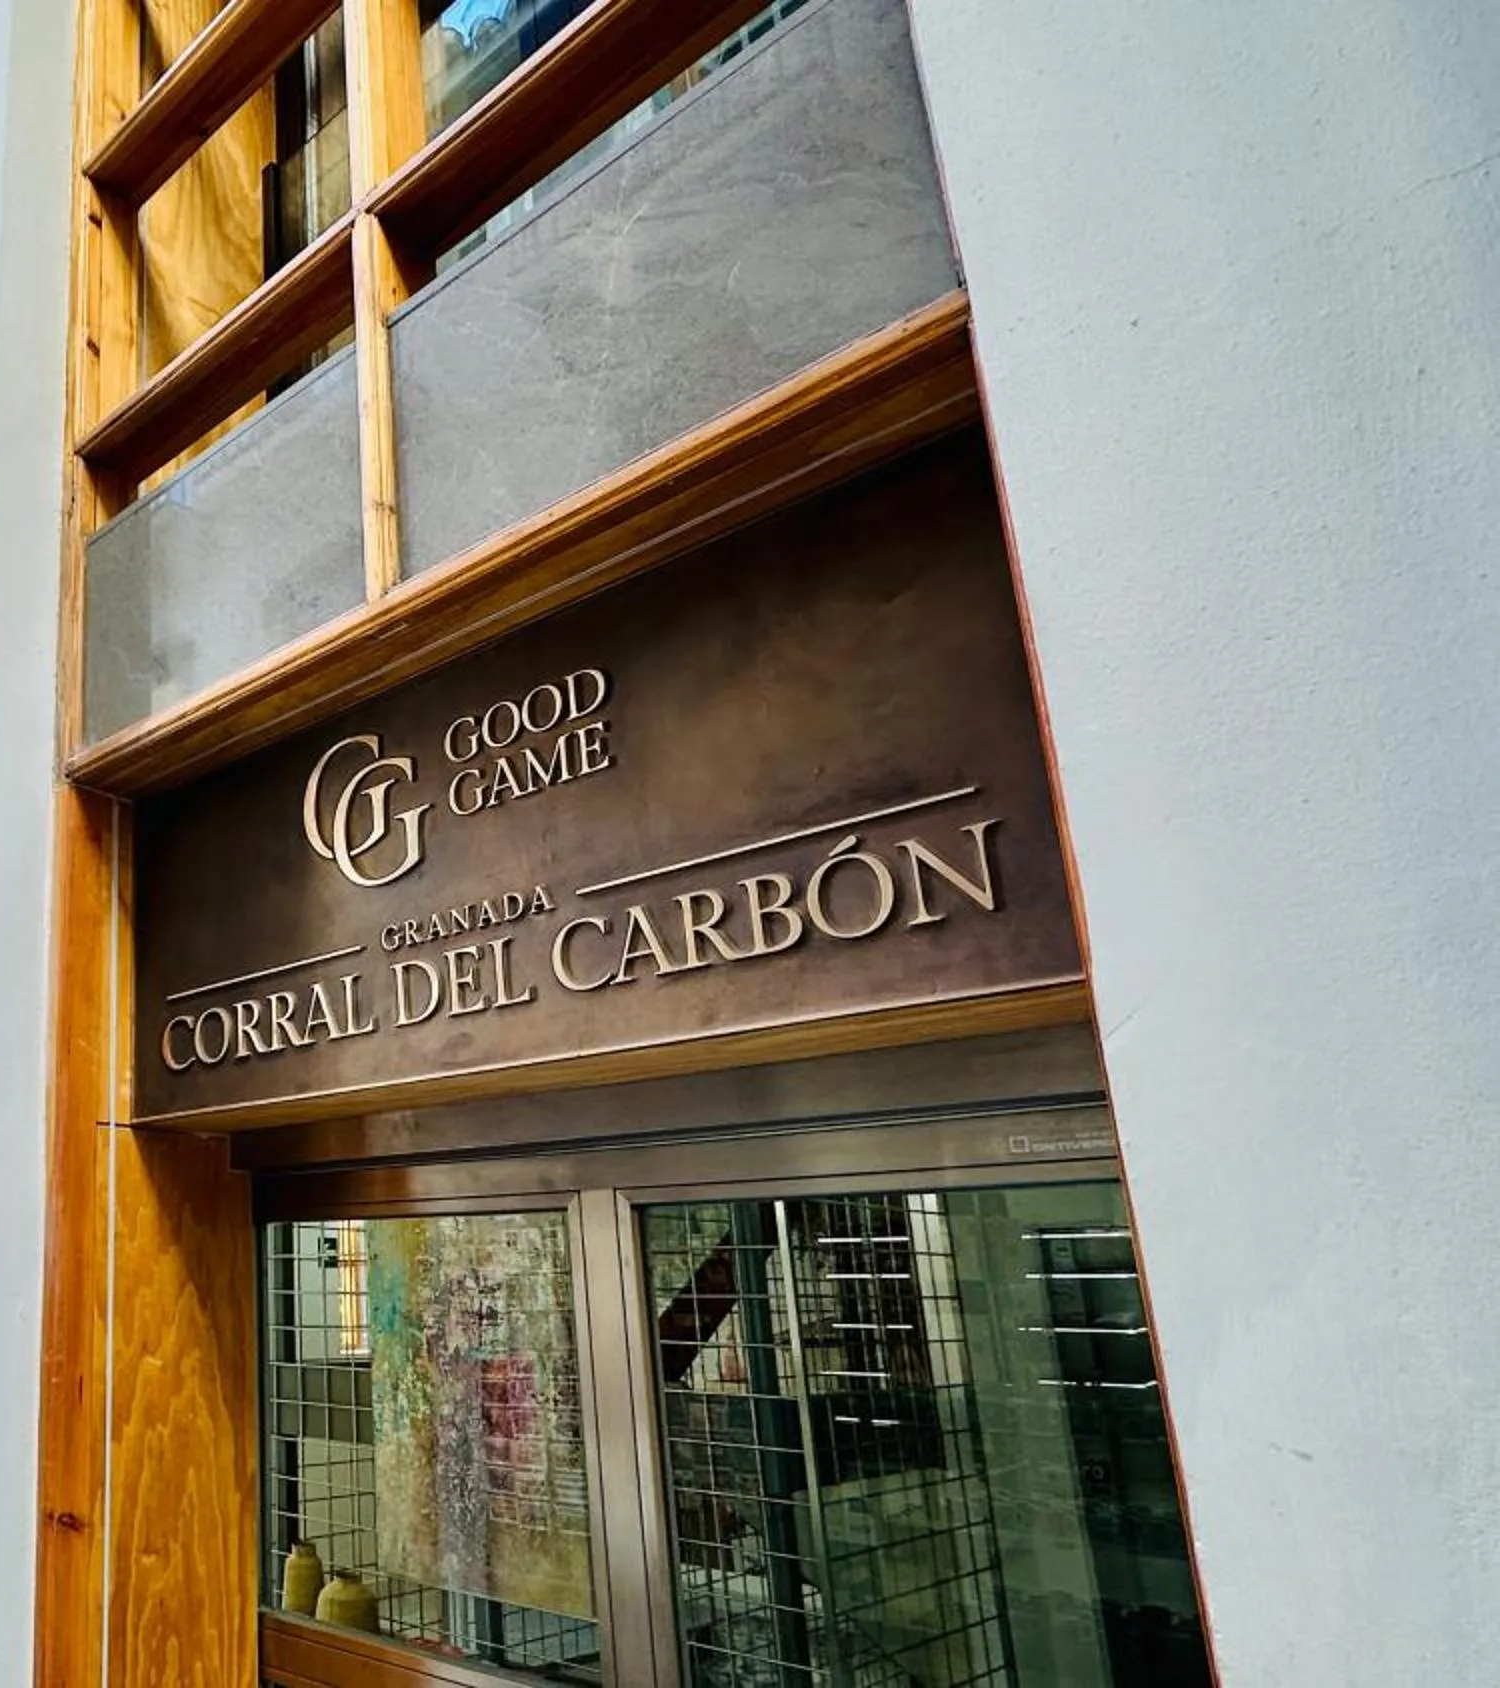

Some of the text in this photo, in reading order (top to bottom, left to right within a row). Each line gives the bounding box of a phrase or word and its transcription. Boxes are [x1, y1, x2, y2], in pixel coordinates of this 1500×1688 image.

[444, 668, 607, 763] GOOD
[448, 721, 610, 816] GAME
[161, 818, 1003, 1071] CORRAL DEL CARBÓN
[380, 883, 556, 951] GRANADA
